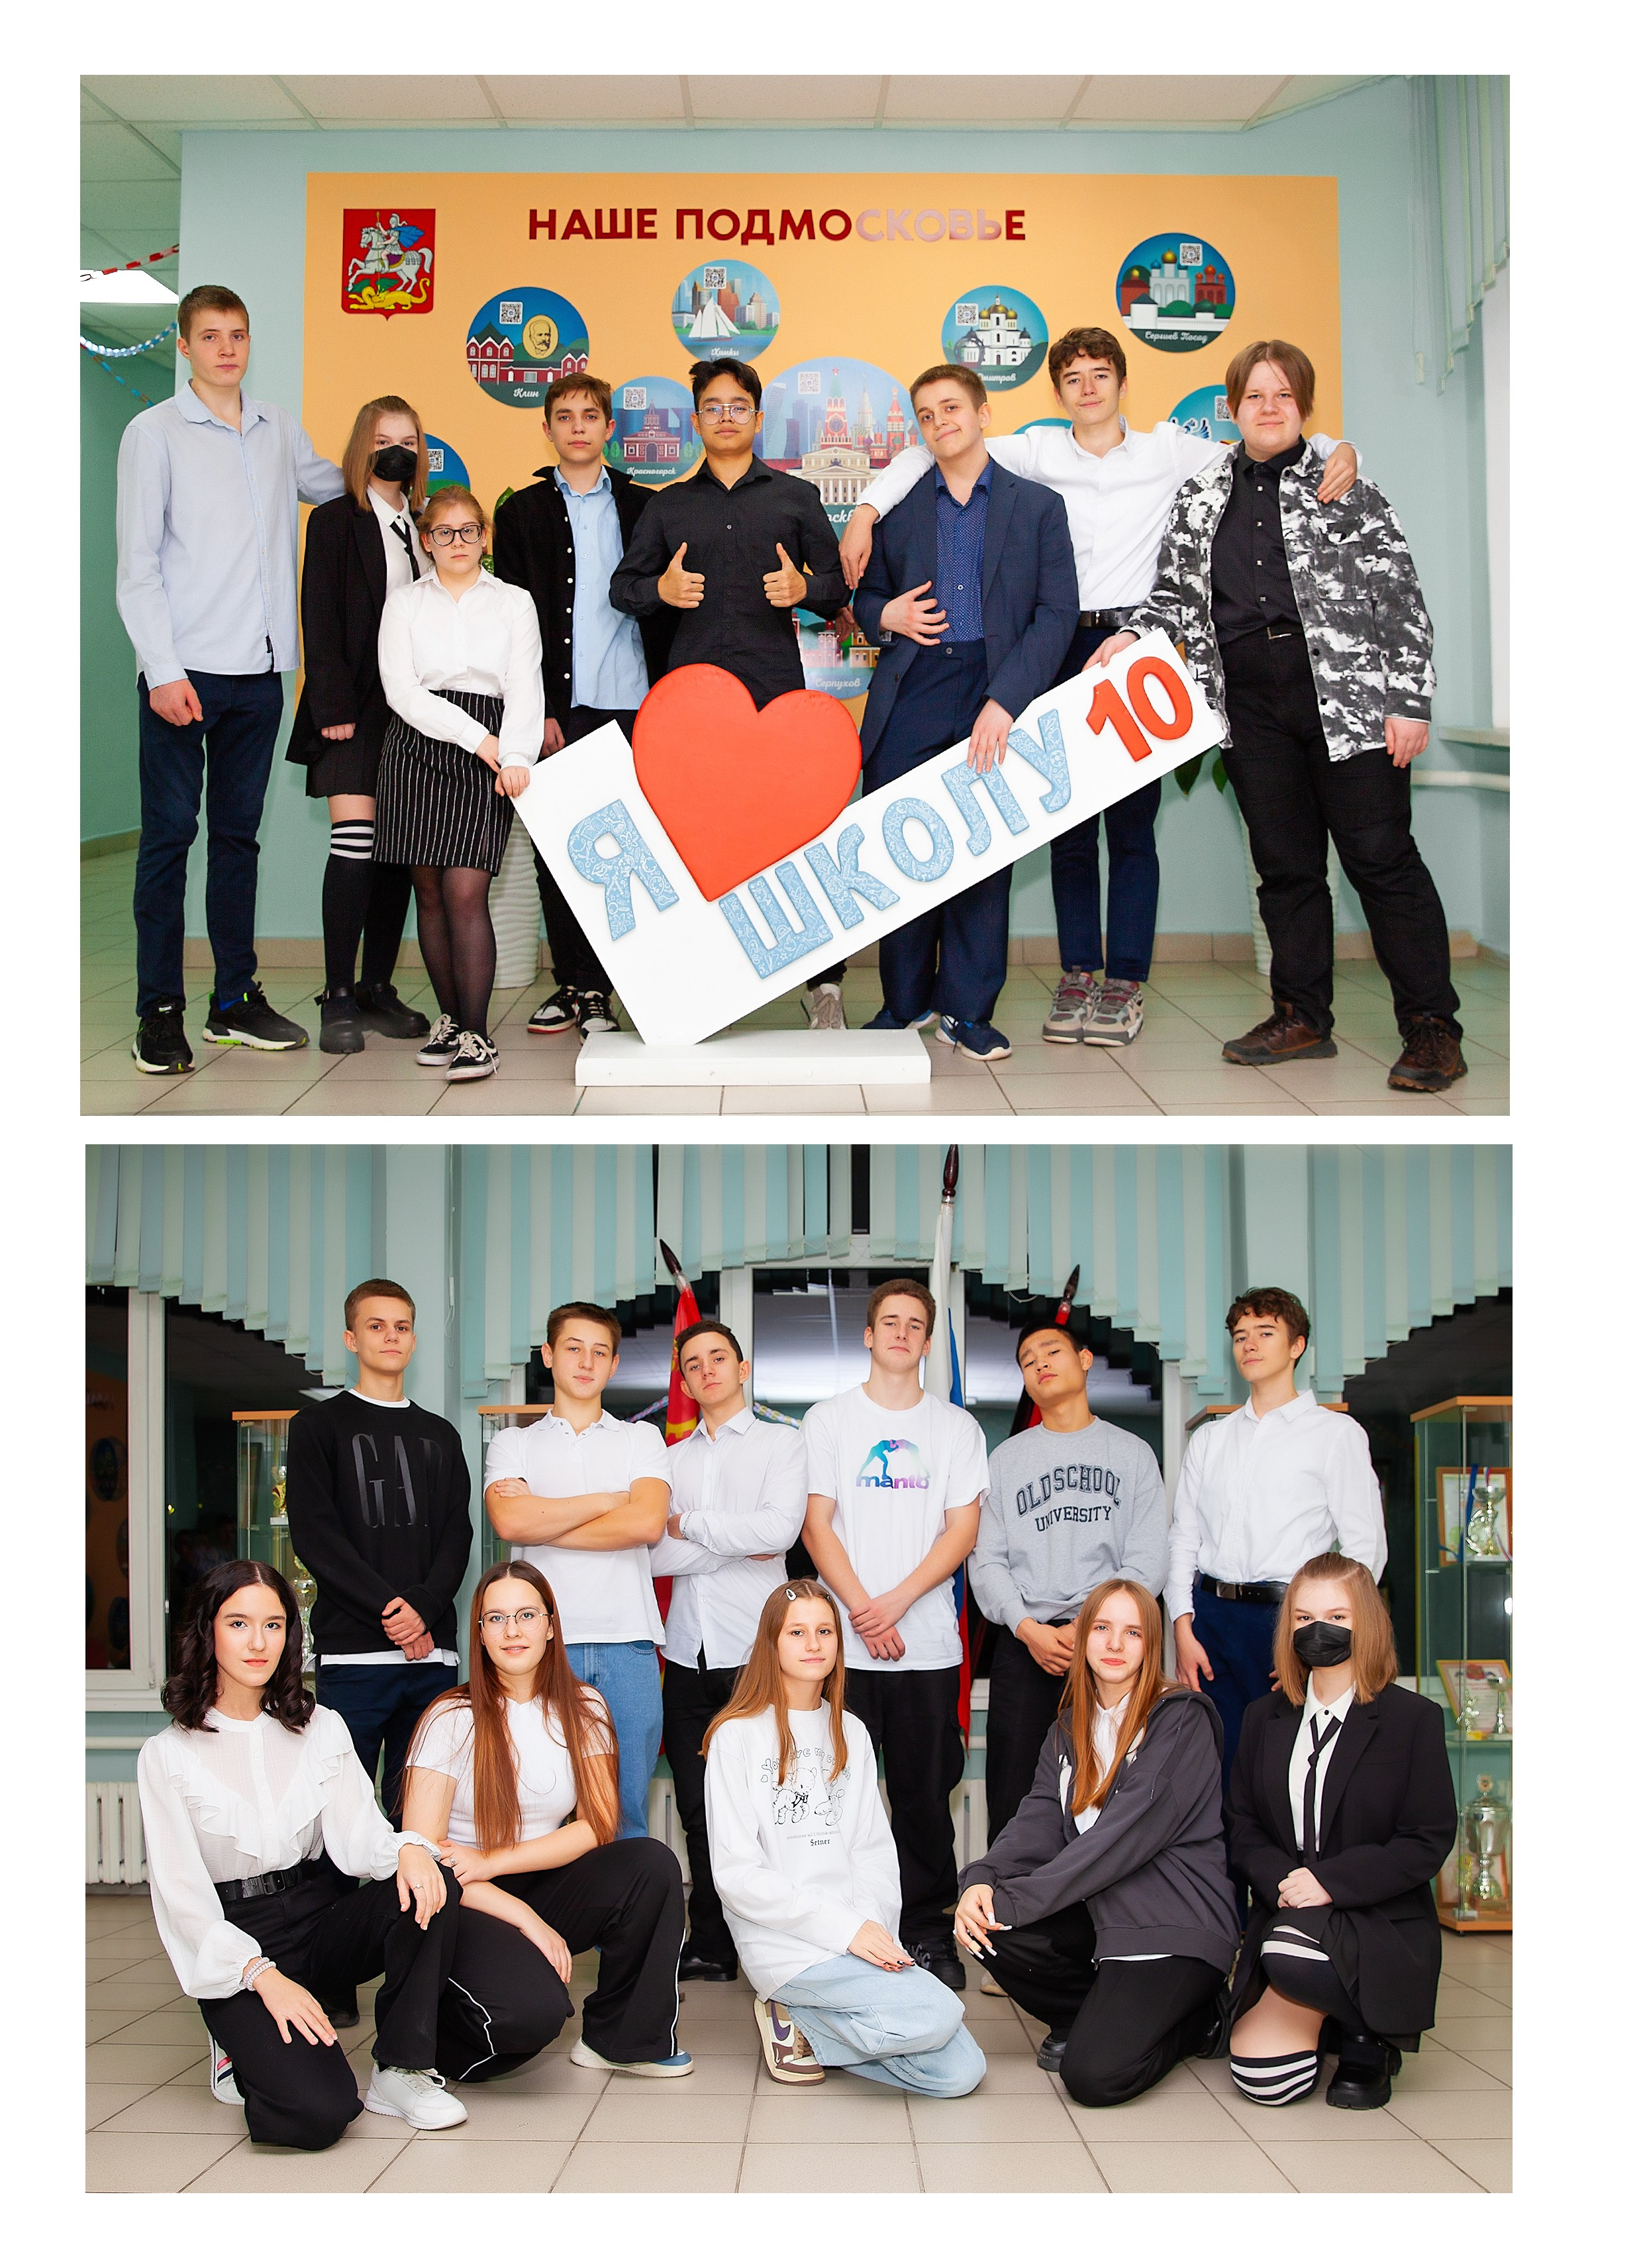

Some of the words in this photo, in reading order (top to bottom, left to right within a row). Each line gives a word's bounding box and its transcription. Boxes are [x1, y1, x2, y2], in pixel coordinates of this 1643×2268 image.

[529, 208, 658, 240] НАШЕ
[676, 208, 1026, 246] ПОДМОСКОВЬЕ
[1145, 330, 1179, 342] Сергиев
[1180, 332, 1208, 344] Посад
[513, 387, 540, 397] Клин
[815, 677, 861, 690] Серпухов
[718, 708, 1071, 980] ШКОЛУ
[1085, 656, 1193, 763] 10
[567, 799, 680, 942] Я
[856, 1475, 930, 1489] manto
[1035, 1506, 1112, 1532] UNIVERSITY
